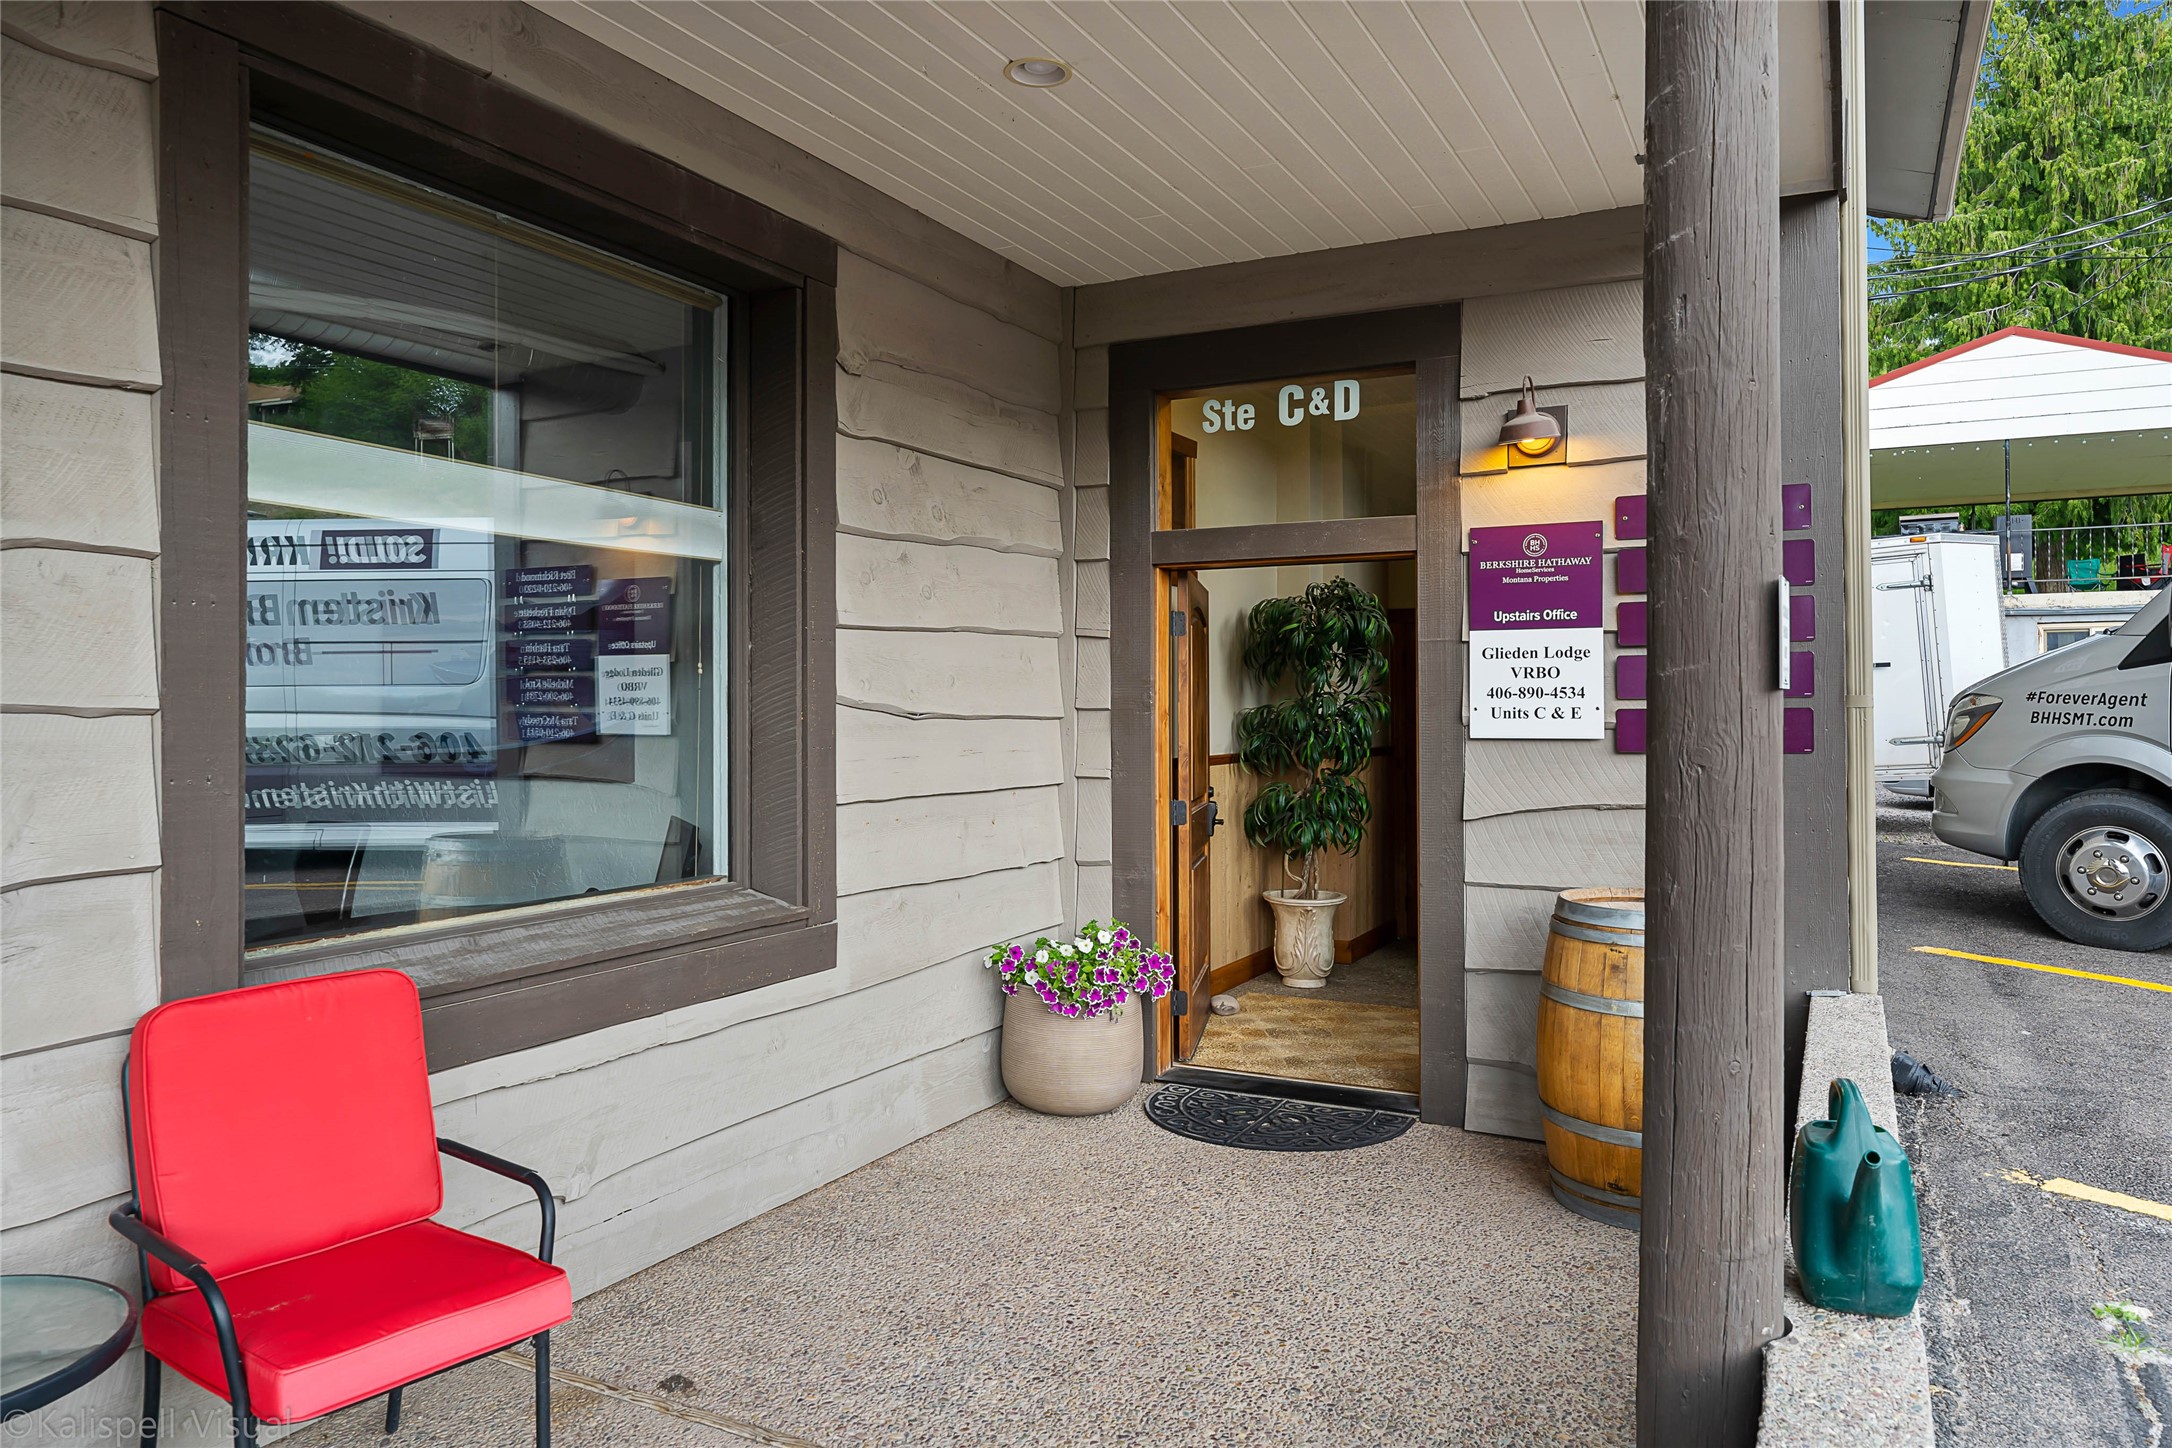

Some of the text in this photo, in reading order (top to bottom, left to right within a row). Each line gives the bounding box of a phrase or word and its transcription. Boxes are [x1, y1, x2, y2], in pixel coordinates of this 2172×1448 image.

[1202, 399, 1256, 434] Ste
[1480, 557, 1592, 569] BERKSHIRE HATHAWAY
[1502, 574, 1569, 584] Montana Properties
[1494, 608, 1578, 624] Upstairs Office
[1482, 646, 1591, 662] Glieden Lodge
[1511, 666, 1561, 679] VRBO
[1486, 686, 1586, 699] 406-890-4534
[2025, 691, 2148, 710] #ForeverAgent
[1490, 706, 1582, 720] Units C & E
[2030, 711, 2134, 727] BHHSMT.com
